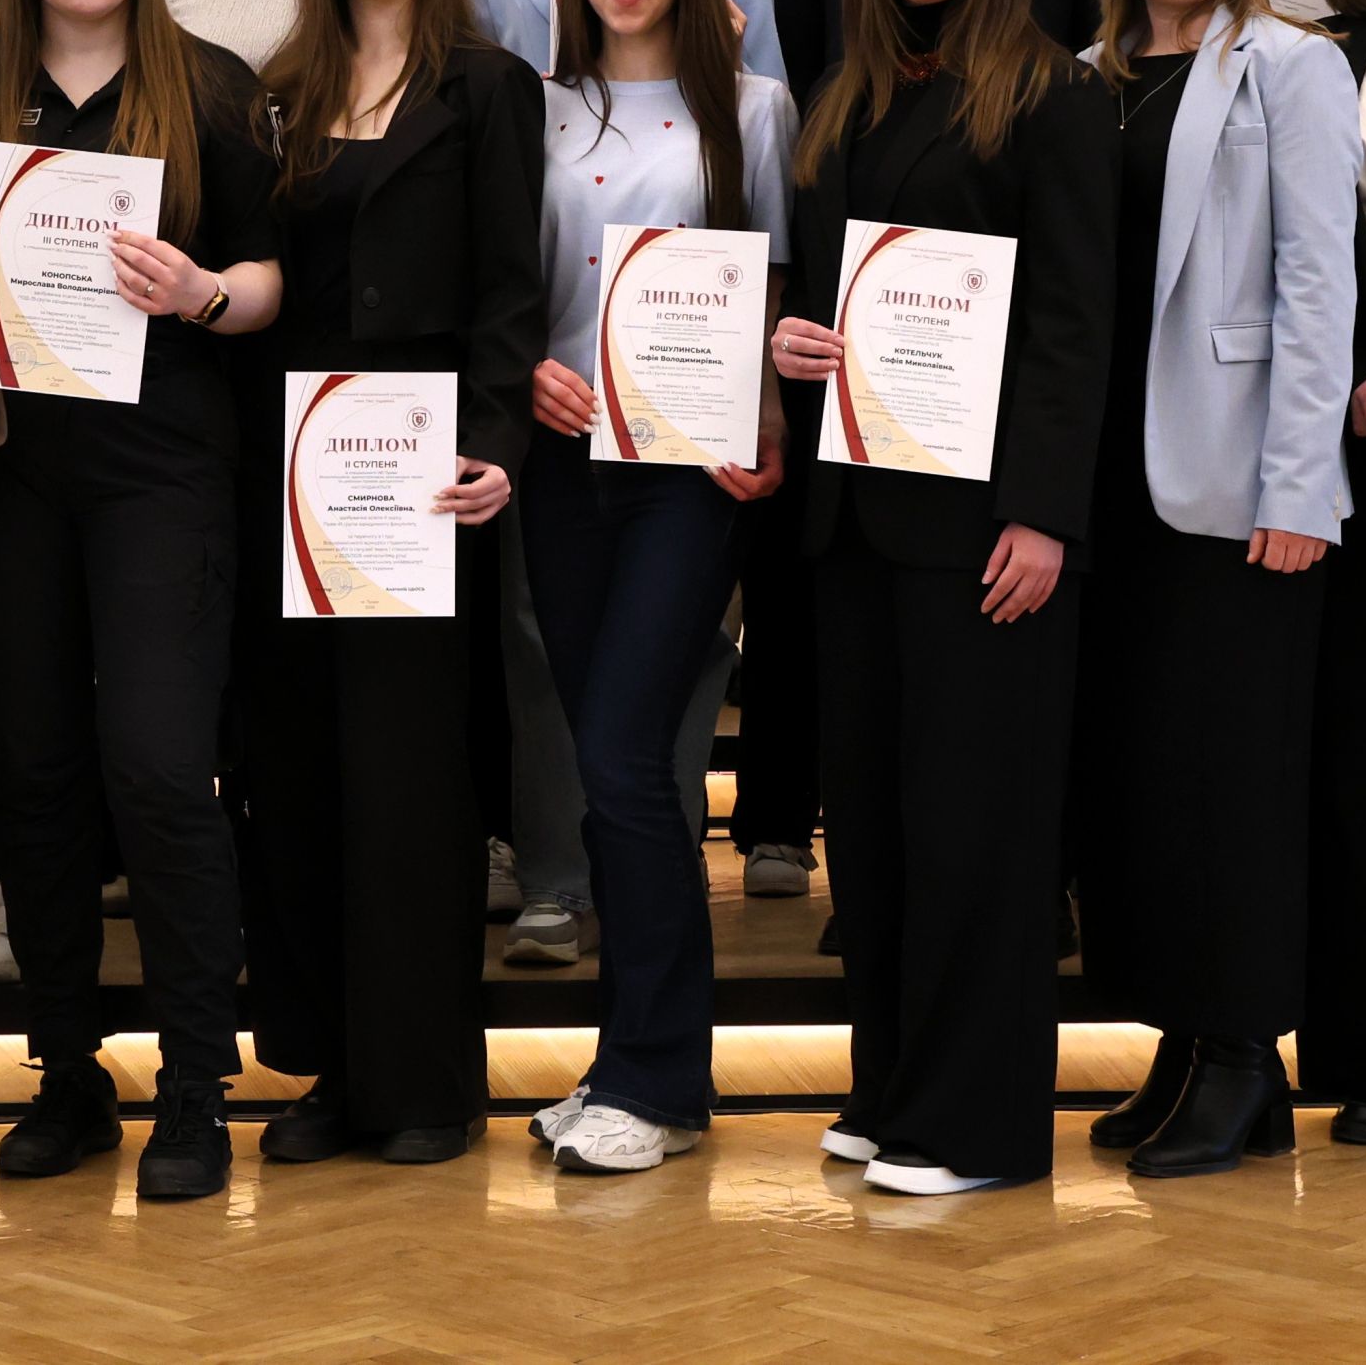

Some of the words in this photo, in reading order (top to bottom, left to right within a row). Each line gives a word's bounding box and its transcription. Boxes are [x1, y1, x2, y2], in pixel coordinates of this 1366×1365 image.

[25, 212, 119, 234] ДИПЛОМ
[54, 237, 98, 249] СТУПЕНЯ
[42, 271, 92, 282] КОНОПСЬКА
[10, 278, 55, 289] Мирослава
[57, 282, 120, 296] Володимирівна
[638, 289, 728, 307] ДИПЛОМ
[877, 289, 971, 313] ДИПЛОМ
[665, 313, 708, 322] СТУПЕНЯ
[905, 314, 950, 327] СТУПЕНЯ
[649, 345, 711, 355] КОШУЛИНСЬКА
[894, 348, 943, 359] КОТЕЛЬЧУК
[636, 354, 659, 362] Софія
[880, 356, 903, 366] Софія
[325, 438, 417, 452] ДИПЛОМ
[354, 461, 398, 469] СТУПЕНЯ
